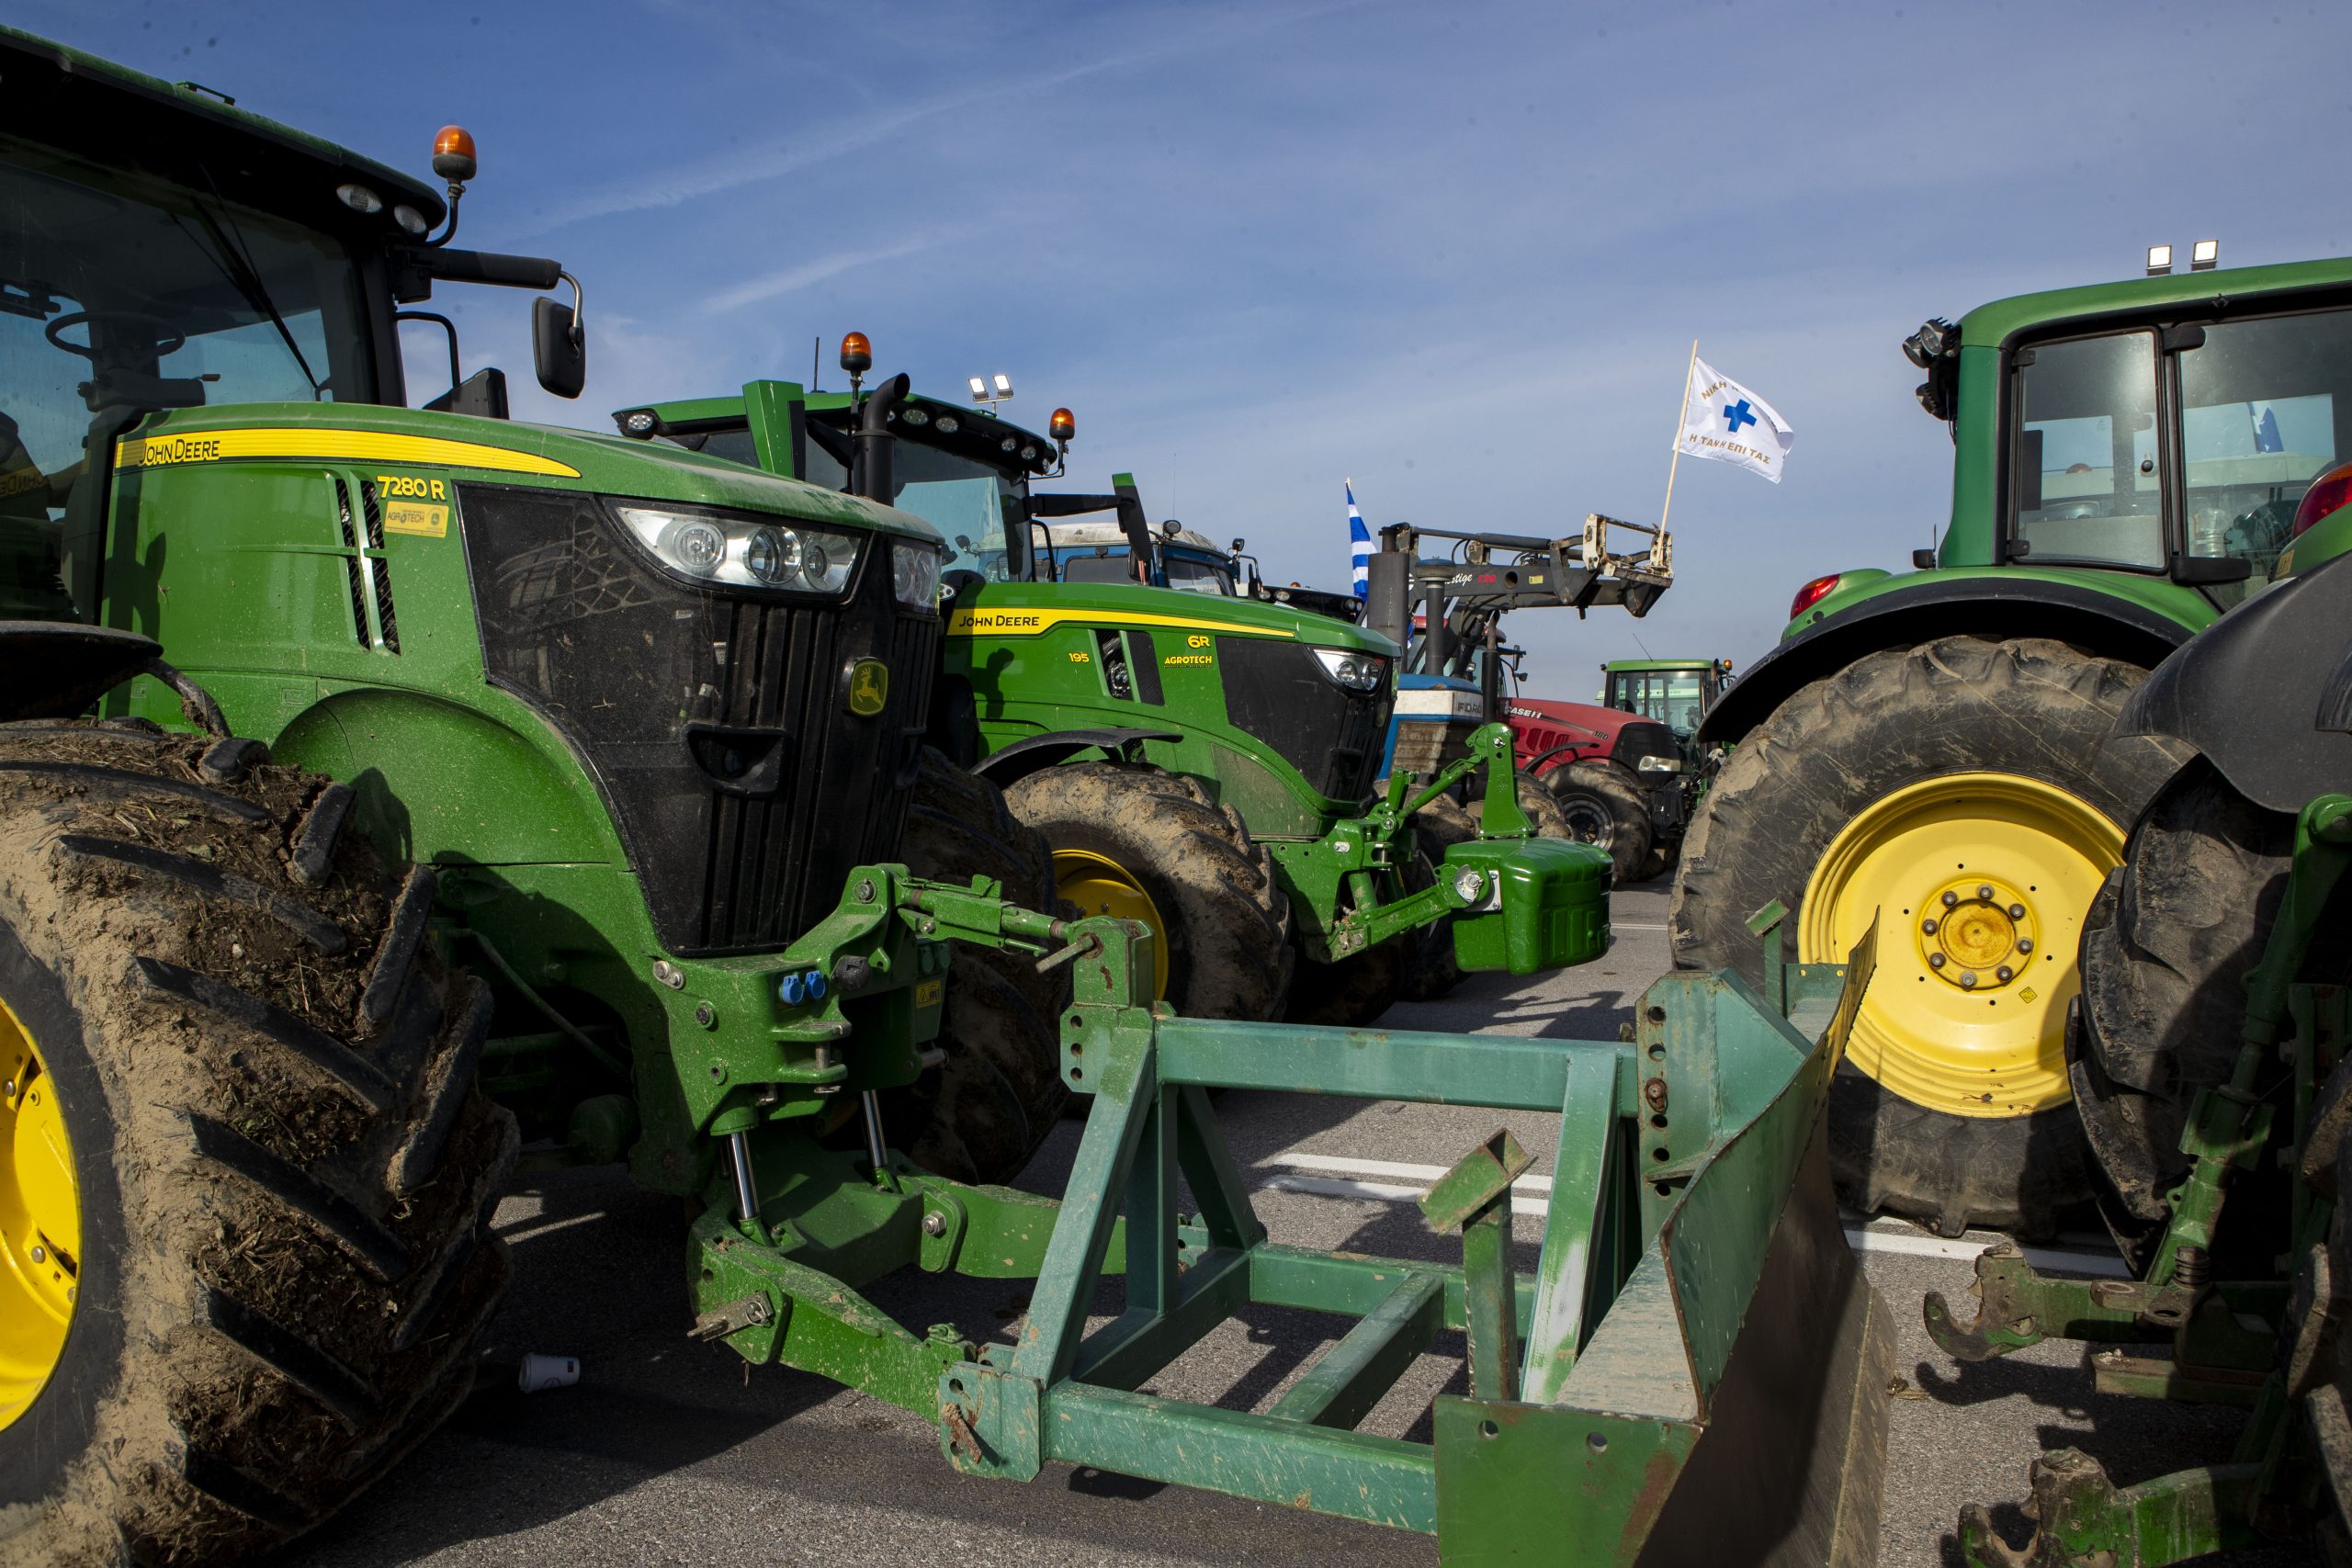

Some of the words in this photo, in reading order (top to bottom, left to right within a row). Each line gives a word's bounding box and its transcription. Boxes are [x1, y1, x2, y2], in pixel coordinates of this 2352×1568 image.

[1701, 381, 1727, 400] ΝΙΚΗ
[140, 442, 174, 465] JOHN
[174, 439, 220, 460] DEERE
[1689, 434, 1698, 442] Η
[1701, 436, 1720, 447] ΤΑΝ
[1727, 442, 1747, 455] ΕΠΙ
[1749, 448, 1771, 465] ΤΑΣ
[377, 475, 428, 499] 7280
[430, 479, 447, 501] R
[959, 615, 992, 627] JOHN
[995, 615, 1040, 626] DEERE
[1187, 635, 1211, 649] 6R
[1068, 652, 1090, 663] 195
[1164, 655, 1212, 664] AGROTECH
[1594, 730, 1610, 740] 180
